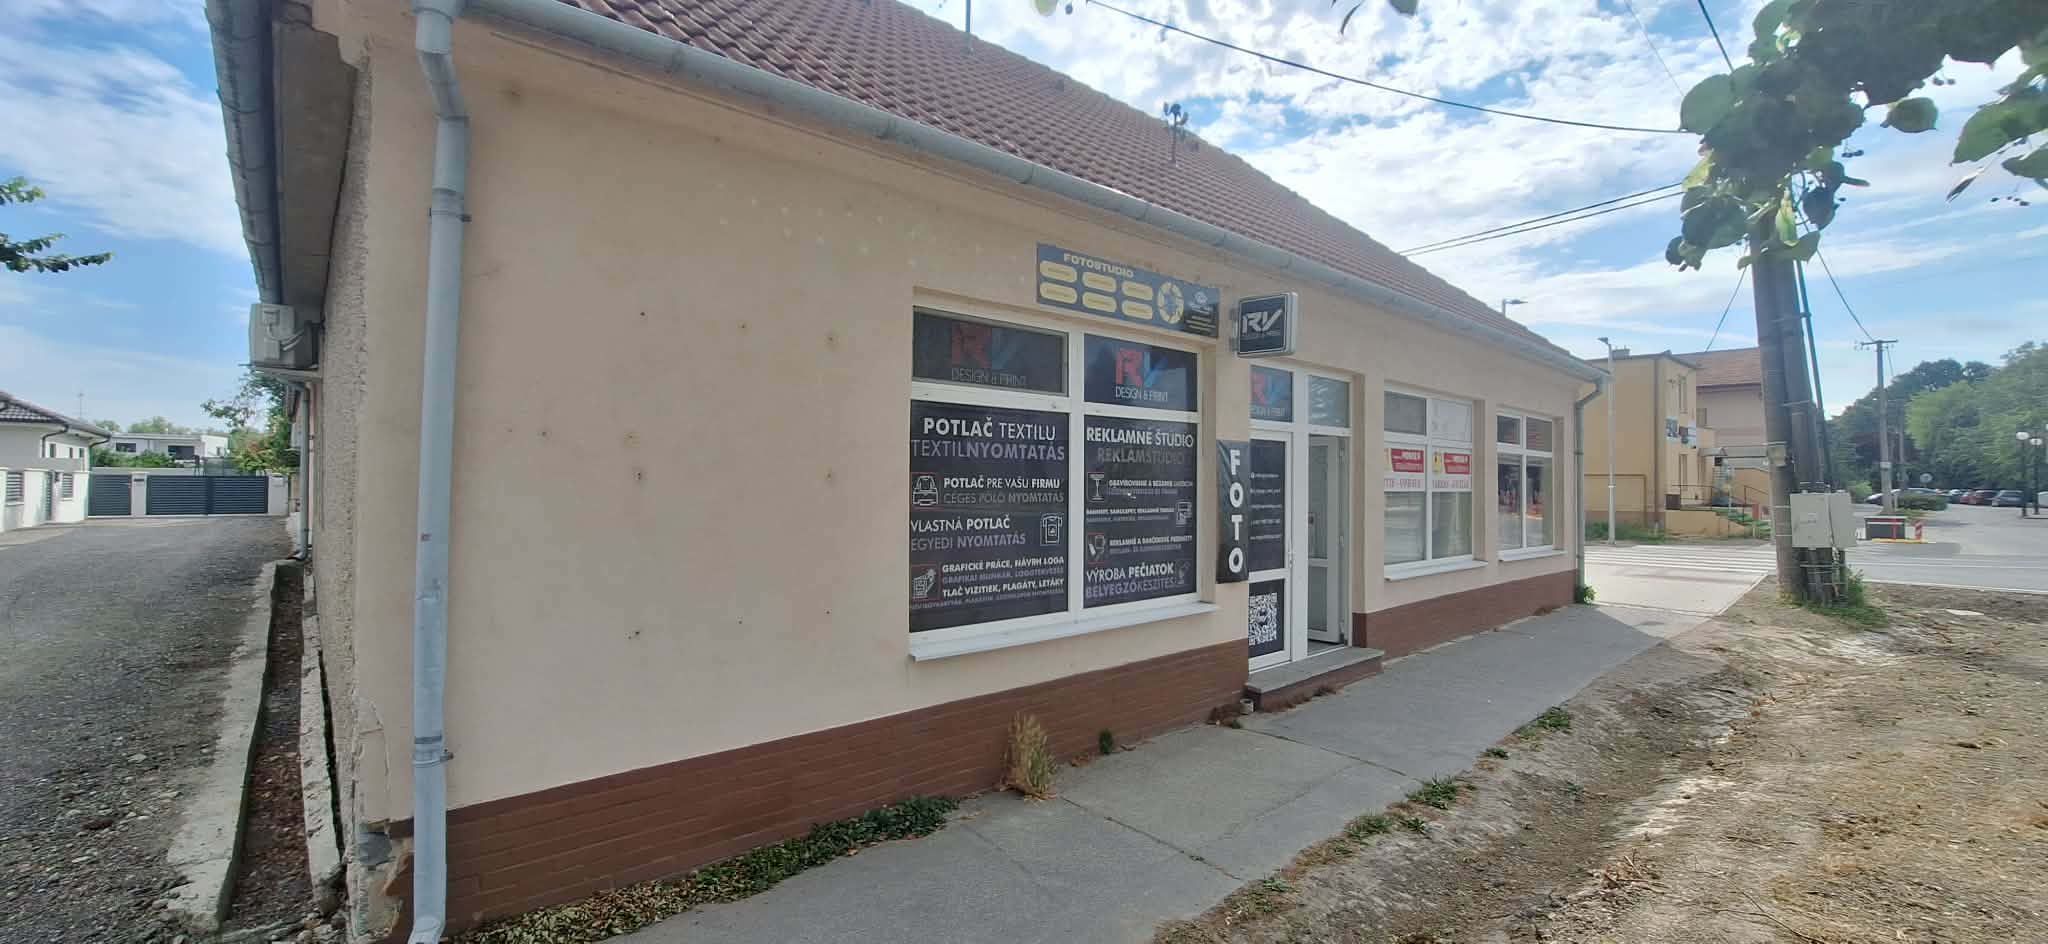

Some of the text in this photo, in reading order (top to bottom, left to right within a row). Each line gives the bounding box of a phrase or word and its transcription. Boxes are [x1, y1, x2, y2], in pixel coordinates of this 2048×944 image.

[1064, 253, 1134, 278] FOTOSTUDIO
[1241, 307, 1283, 335] RV
[952, 368, 990, 384] DESIGN
[1115, 386, 1142, 400] DESIGN
[923, 417, 1056, 441] POTLAČ TEXTILU
[943, 475, 985, 489] POTLAČ
[987, 478, 1003, 489] PRE
[1031, 478, 1061, 489] FIRMU
[1229, 449, 1244, 573] FOTO
[911, 514, 1010, 533] VLASTNÁ POTLAČ
[911, 532, 1027, 551] EGYEDI NYOMTATÁS
[1043, 555, 1065, 565] LOGA
[1086, 562, 1174, 584] VÝROBA PEČIATOK
[942, 586, 963, 598] TLAČ
[1038, 576, 1065, 588] LETÁKY
